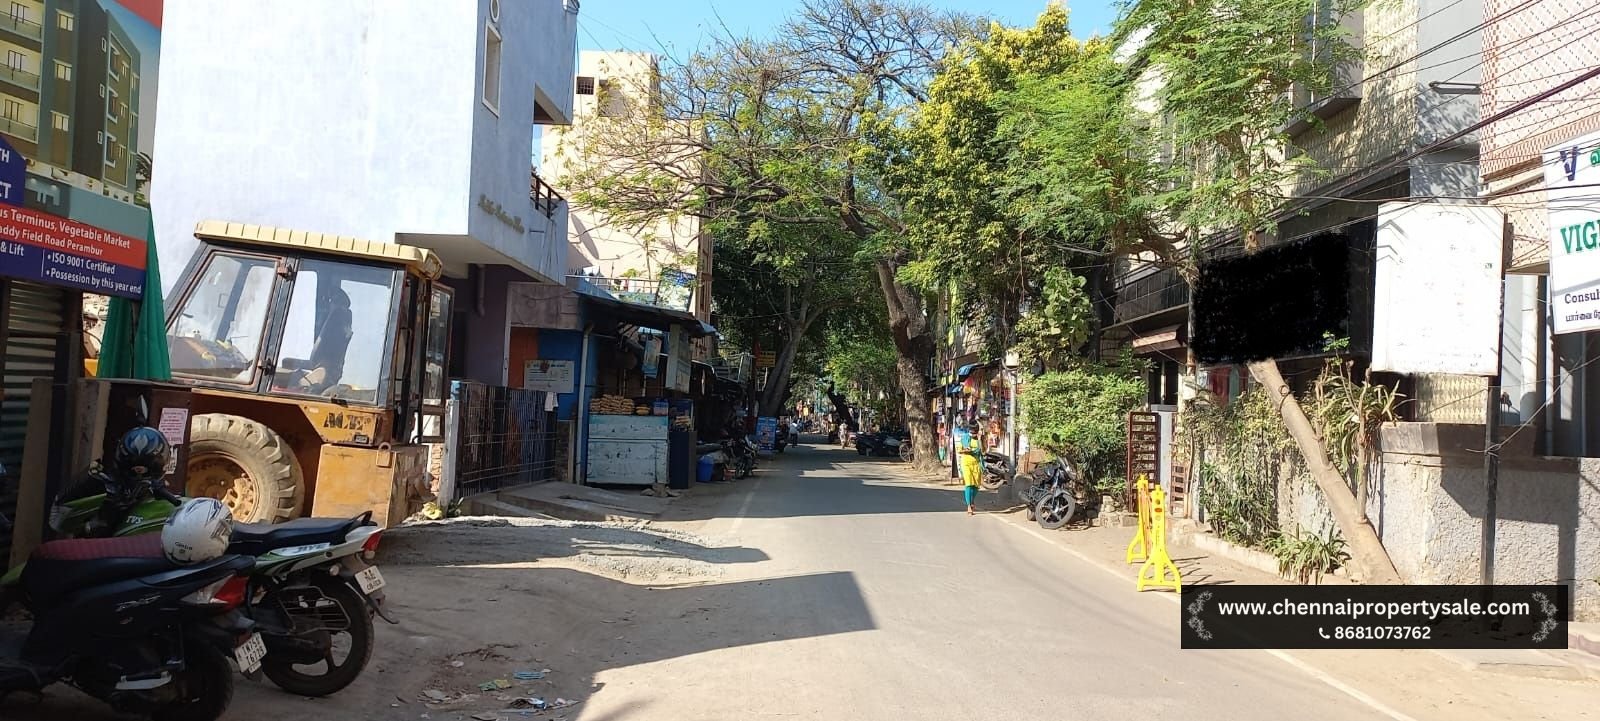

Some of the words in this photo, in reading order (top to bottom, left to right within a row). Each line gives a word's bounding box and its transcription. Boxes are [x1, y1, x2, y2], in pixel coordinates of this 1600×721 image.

[11, 209, 57, 232] Terminus,
[59, 220, 102, 241] Vegetable
[103, 232, 130, 249] Market
[0, 241, 7, 253] &
[9, 243, 24, 257] Lift
[22, 229, 43, 243] Field
[44, 234, 66, 248] Road
[67, 239, 103, 256] Perambur
[52, 251, 66, 265] ISO
[66, 255, 84, 268] 9001
[86, 260, 116, 275] Certified
[51, 267, 90, 284] Possession
[91, 274, 100, 288] by
[101, 277, 114, 289] this
[114, 281, 129, 292] year
[129, 284, 142, 294] end
[126, 516, 144, 524] TVS
